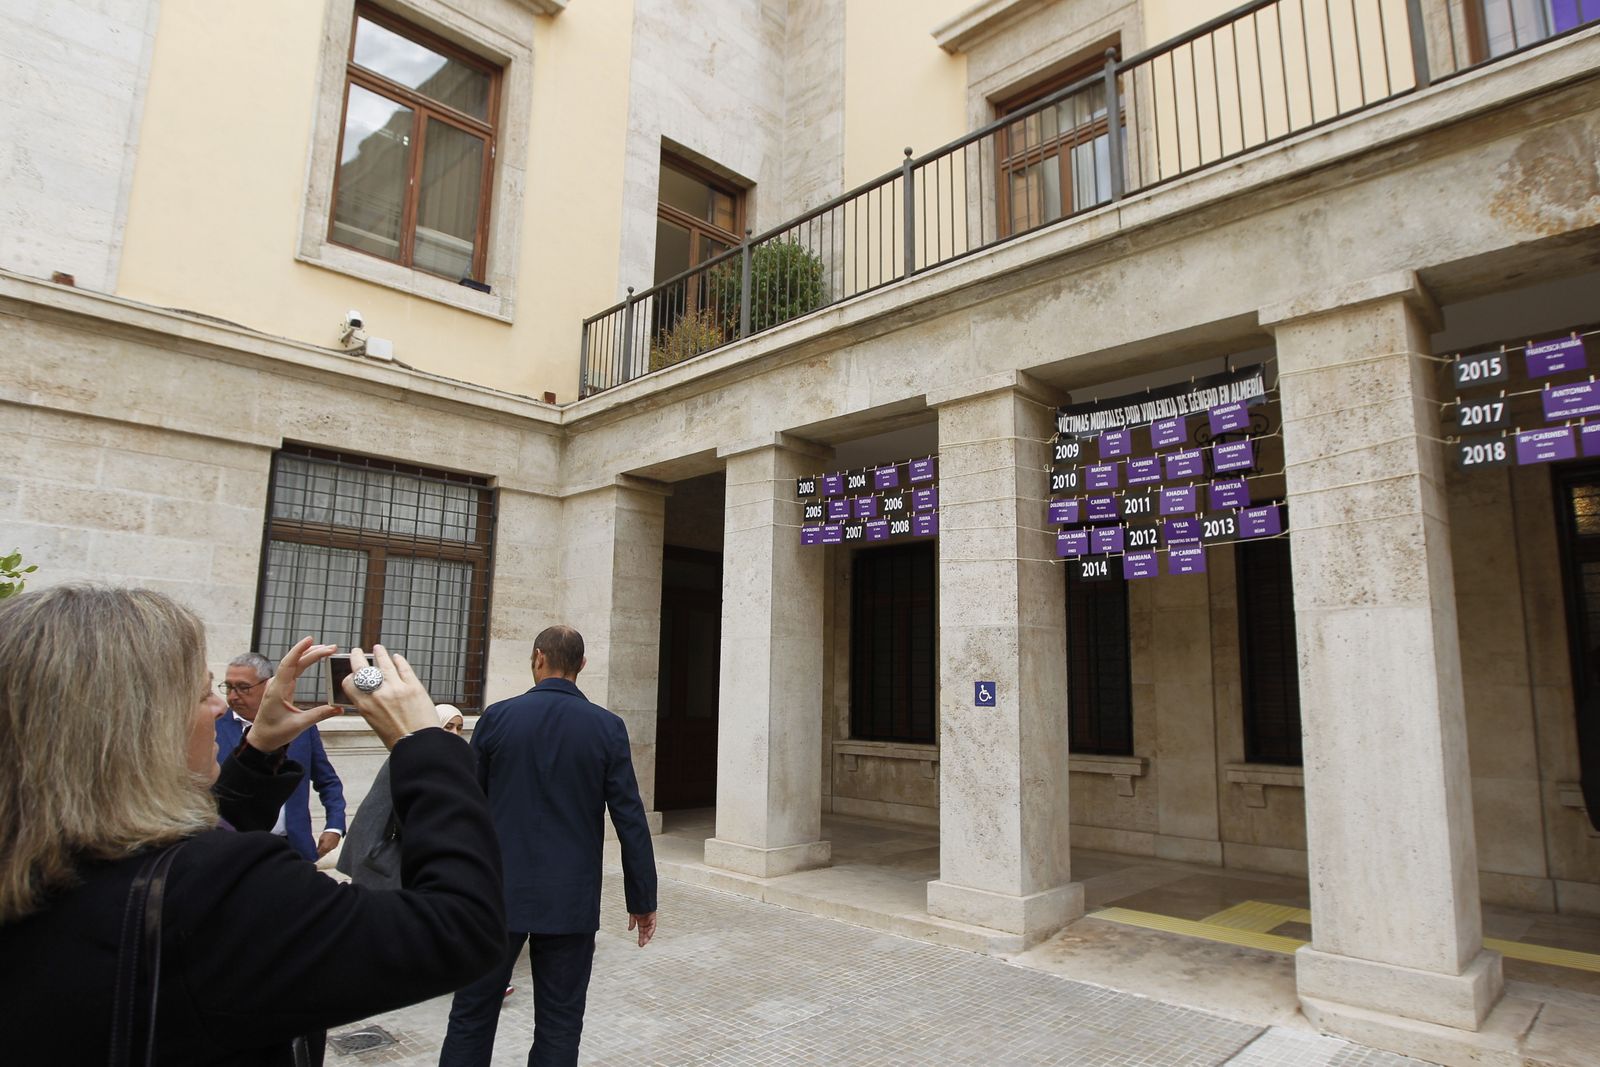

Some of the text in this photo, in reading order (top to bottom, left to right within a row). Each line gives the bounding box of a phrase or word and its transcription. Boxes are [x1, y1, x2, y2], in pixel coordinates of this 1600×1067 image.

[1458, 357, 1502, 382] 2015
[1552, 385, 1592, 398] ANTONIA
[1058, 373, 1265, 433] VÍCTIMAS MORTALES POR VIOLENCIA DE GÉNERO EN ALMERÍA
[1213, 404, 1241, 416] HERMINIA
[1461, 402, 1504, 426] 2017
[1158, 421, 1176, 430] ISABEL
[1532, 430, 1569, 441] CARMEN
[1056, 443, 1079, 459] 2009
[1218, 443, 1246, 454] DAMIANA
[1462, 442, 1506, 465] 2018
[1175, 451, 1200, 461] MERCEDES
[1132, 460, 1153, 468] CARMEN
[799, 482, 814, 494] 2003
[848, 475, 866, 488] 2004
[1052, 473, 1076, 490] 2010
[1215, 482, 1242, 491] ARANTXA
[884, 497, 903, 511] 2006
[1124, 497, 1150, 514] 2011
[806, 506, 822, 518] 2005
[1248, 510, 1267, 518] HAYAT
[845, 526, 862, 539] 2007
[891, 520, 910, 534] 2008
[1203, 517, 1235, 538] 2013
[1129, 528, 1158, 546] 2012
[1128, 554, 1152, 562] MARIANA
[1178, 548, 1202, 556] CARMEN
[1082, 561, 1107, 577] 2014
